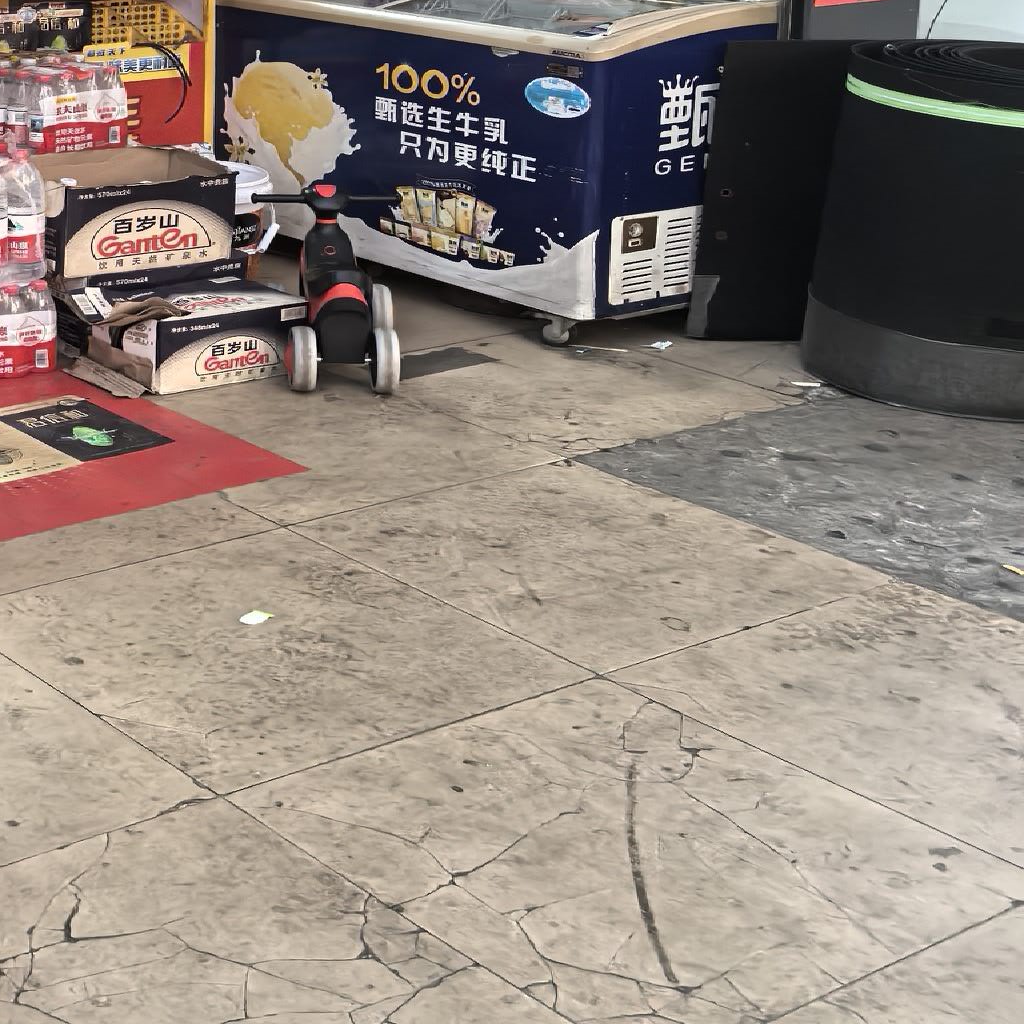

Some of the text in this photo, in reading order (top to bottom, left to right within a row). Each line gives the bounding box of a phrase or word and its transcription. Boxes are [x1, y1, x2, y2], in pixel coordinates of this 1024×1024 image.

[375, 62, 481, 107] 100%
[374, 96, 509, 145] 甄选生牛乳
[399, 130, 537, 183] 只为更纯正
[654, 153, 710, 175] GE
[113, 214, 180, 235] 百岁山
[96, 228, 198, 257] Ganten
[98, 249, 209, 271] 饮用天然矿泉水
[211, 339, 258, 357] 百岁山
[203, 350, 270, 372] Ganten
